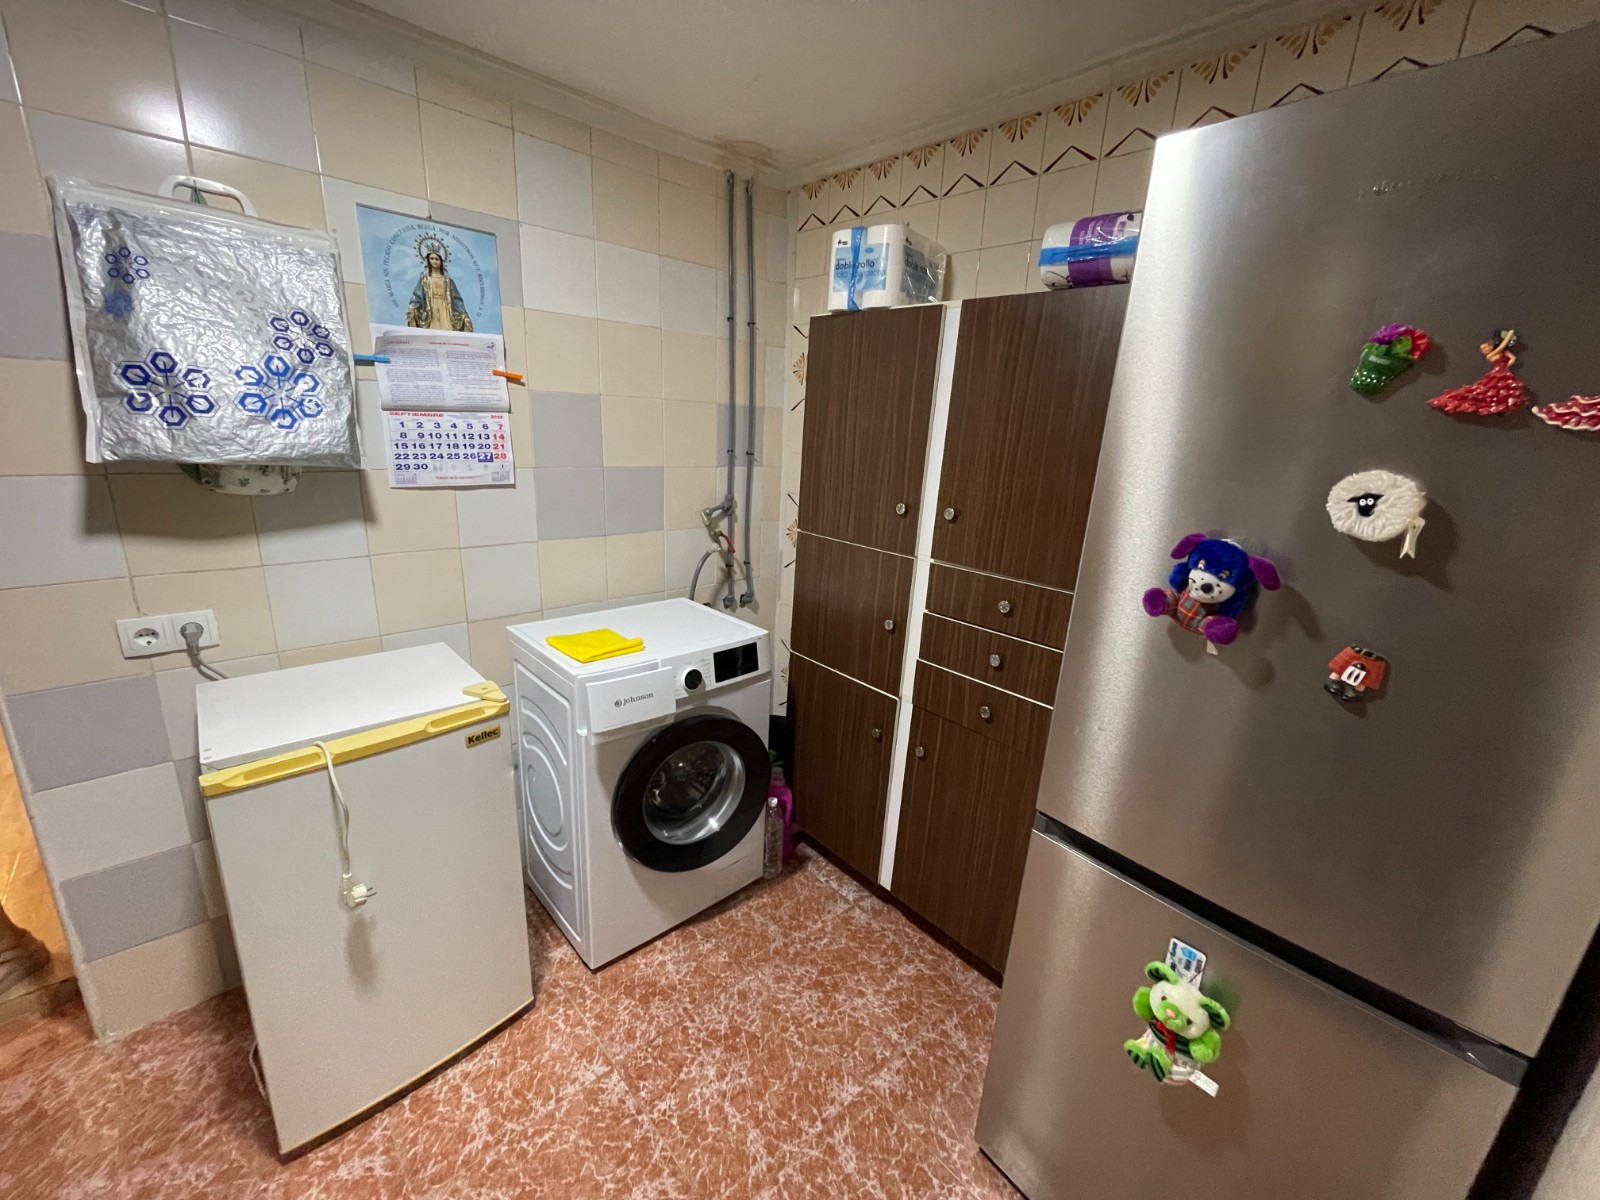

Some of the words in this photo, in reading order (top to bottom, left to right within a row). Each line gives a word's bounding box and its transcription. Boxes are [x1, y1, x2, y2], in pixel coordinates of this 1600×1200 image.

[439, 227, 450, 237] POR
[858, 259, 875, 268] rollo
[478, 452, 492, 460] 27
[395, 463, 411, 471] 29
[622, 692, 654, 706] johnson
[467, 728, 499, 745] Kellec
